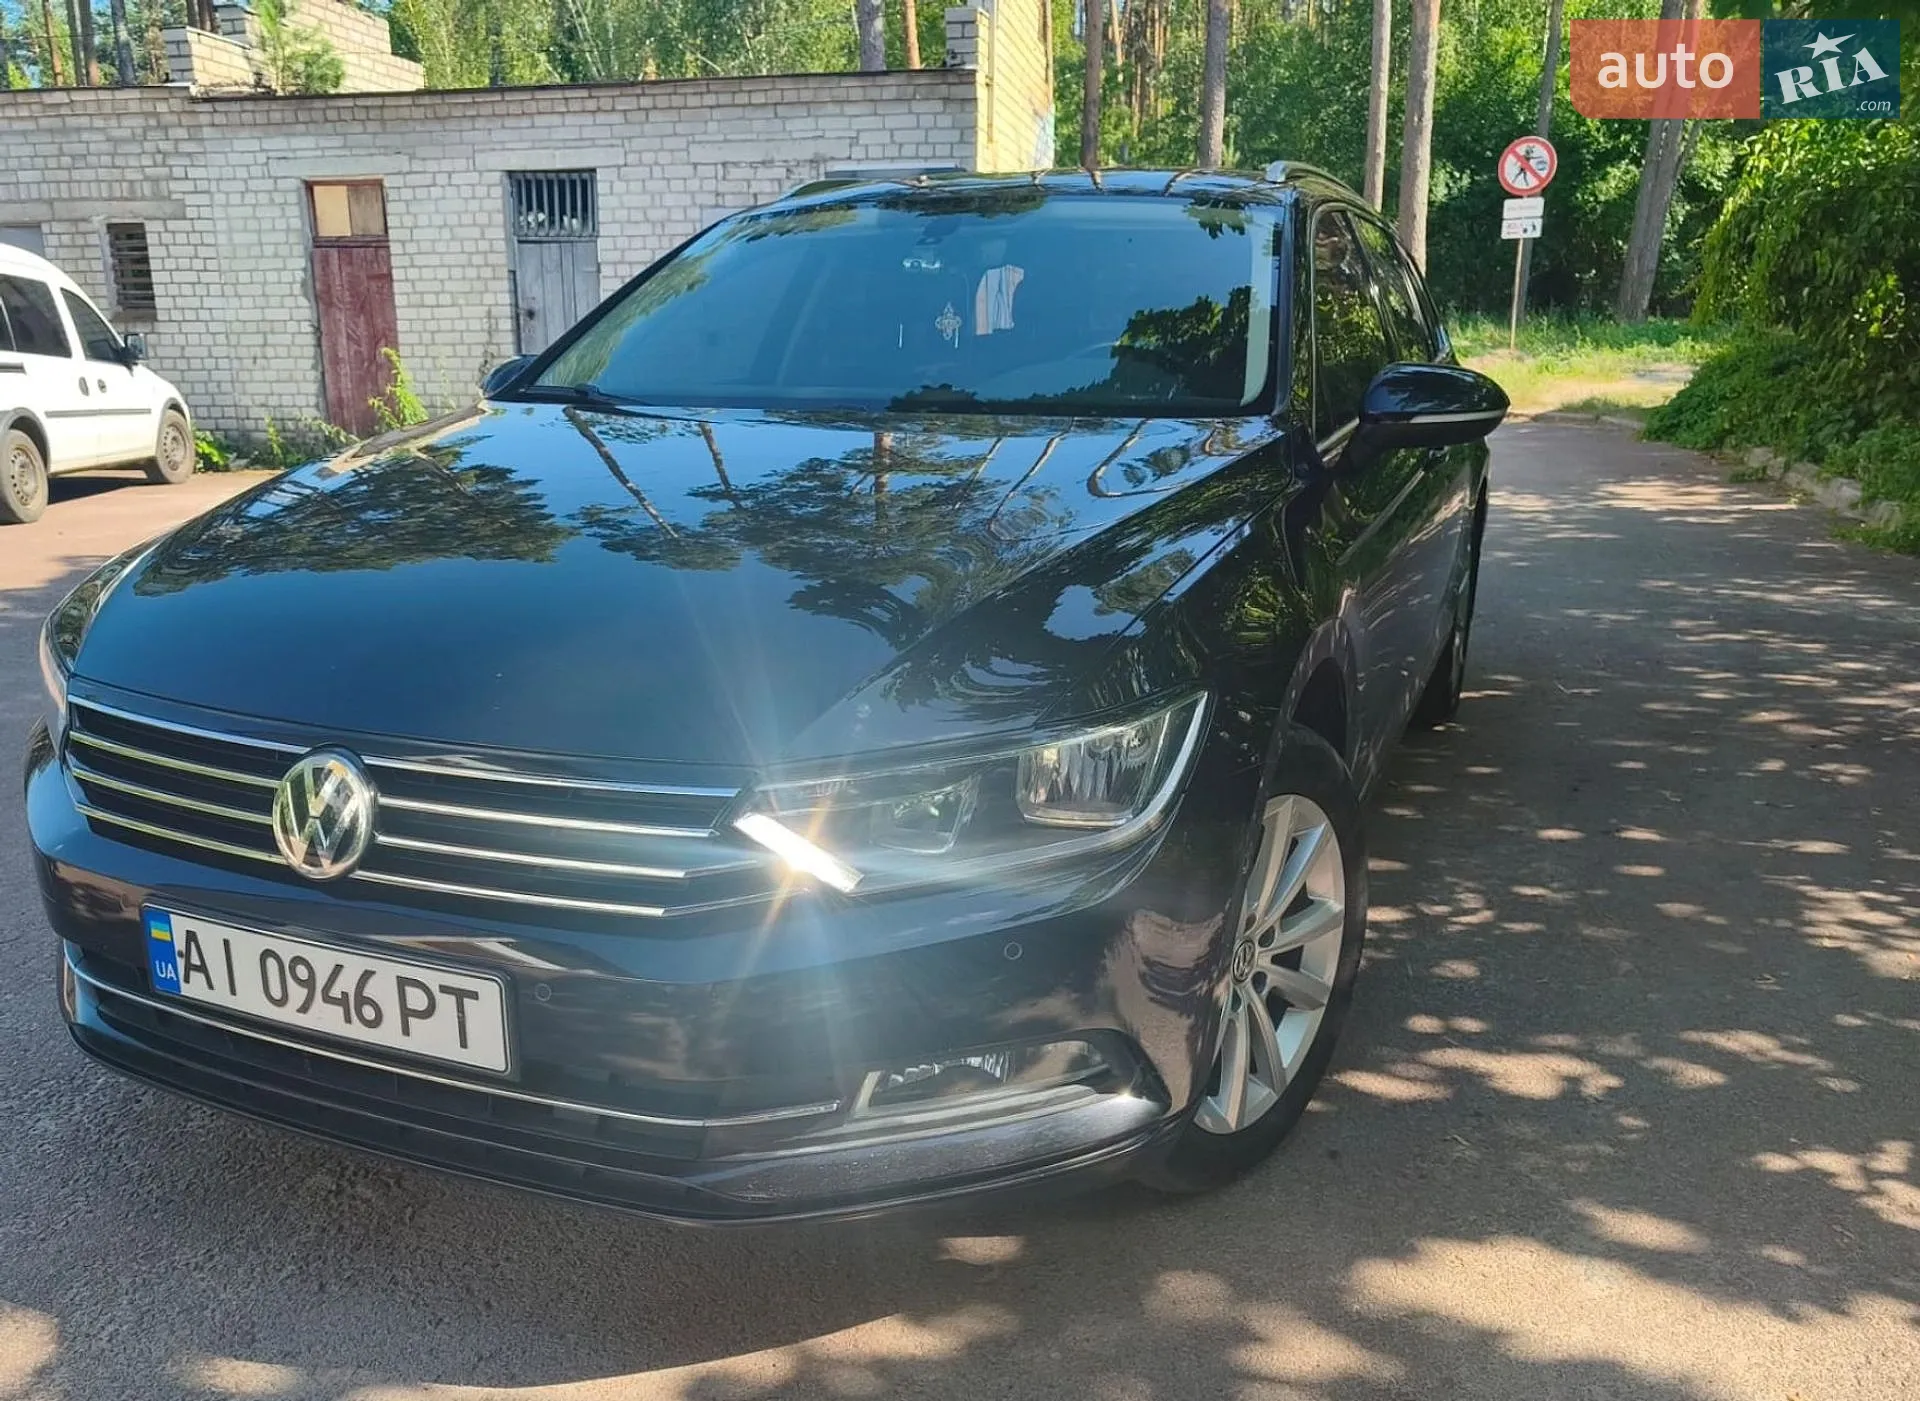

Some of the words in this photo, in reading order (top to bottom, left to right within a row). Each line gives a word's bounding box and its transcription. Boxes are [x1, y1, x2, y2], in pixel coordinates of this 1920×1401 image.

[155, 960, 177, 981] UA
[183, 929, 237, 996] AI
[259, 947, 384, 1030] 0946
[396, 974, 480, 1050] PT
